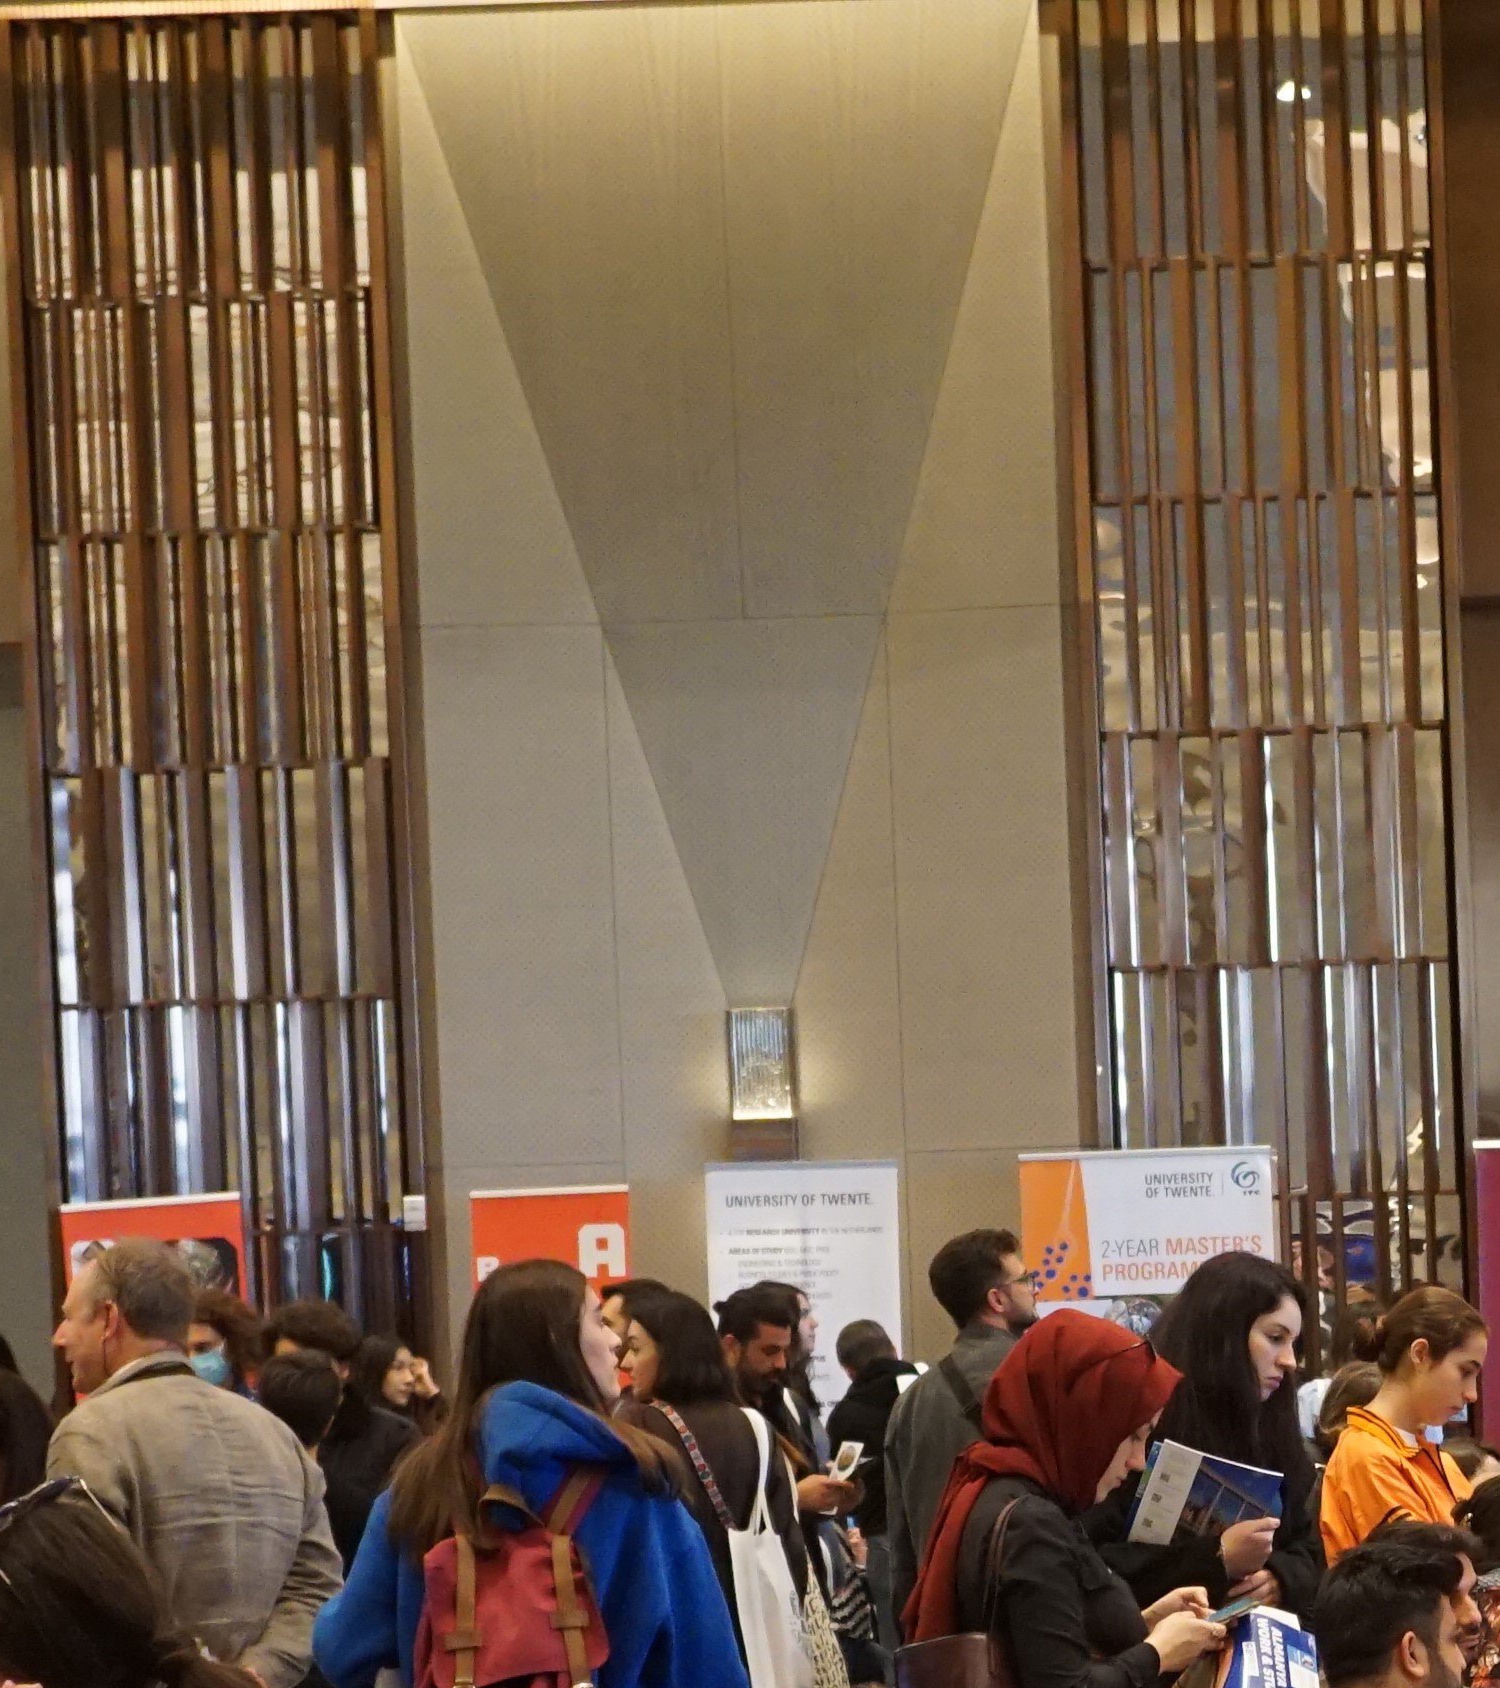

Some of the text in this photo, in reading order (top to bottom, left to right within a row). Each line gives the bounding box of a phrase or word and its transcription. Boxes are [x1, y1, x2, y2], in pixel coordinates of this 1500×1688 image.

[1145, 1172, 1213, 1185] UNIVERSITY
[1146, 1186, 1158, 1198] OF
[725, 1194, 797, 1209] UNIVERSITY
[801, 1194, 816, 1207] OF
[578, 1223, 626, 1277] A
[1101, 1235, 1262, 1259] 2-YEAR MASTER'S
[1256, 1617, 1272, 1653] WORK
[1261, 1653, 1273, 1666] &
